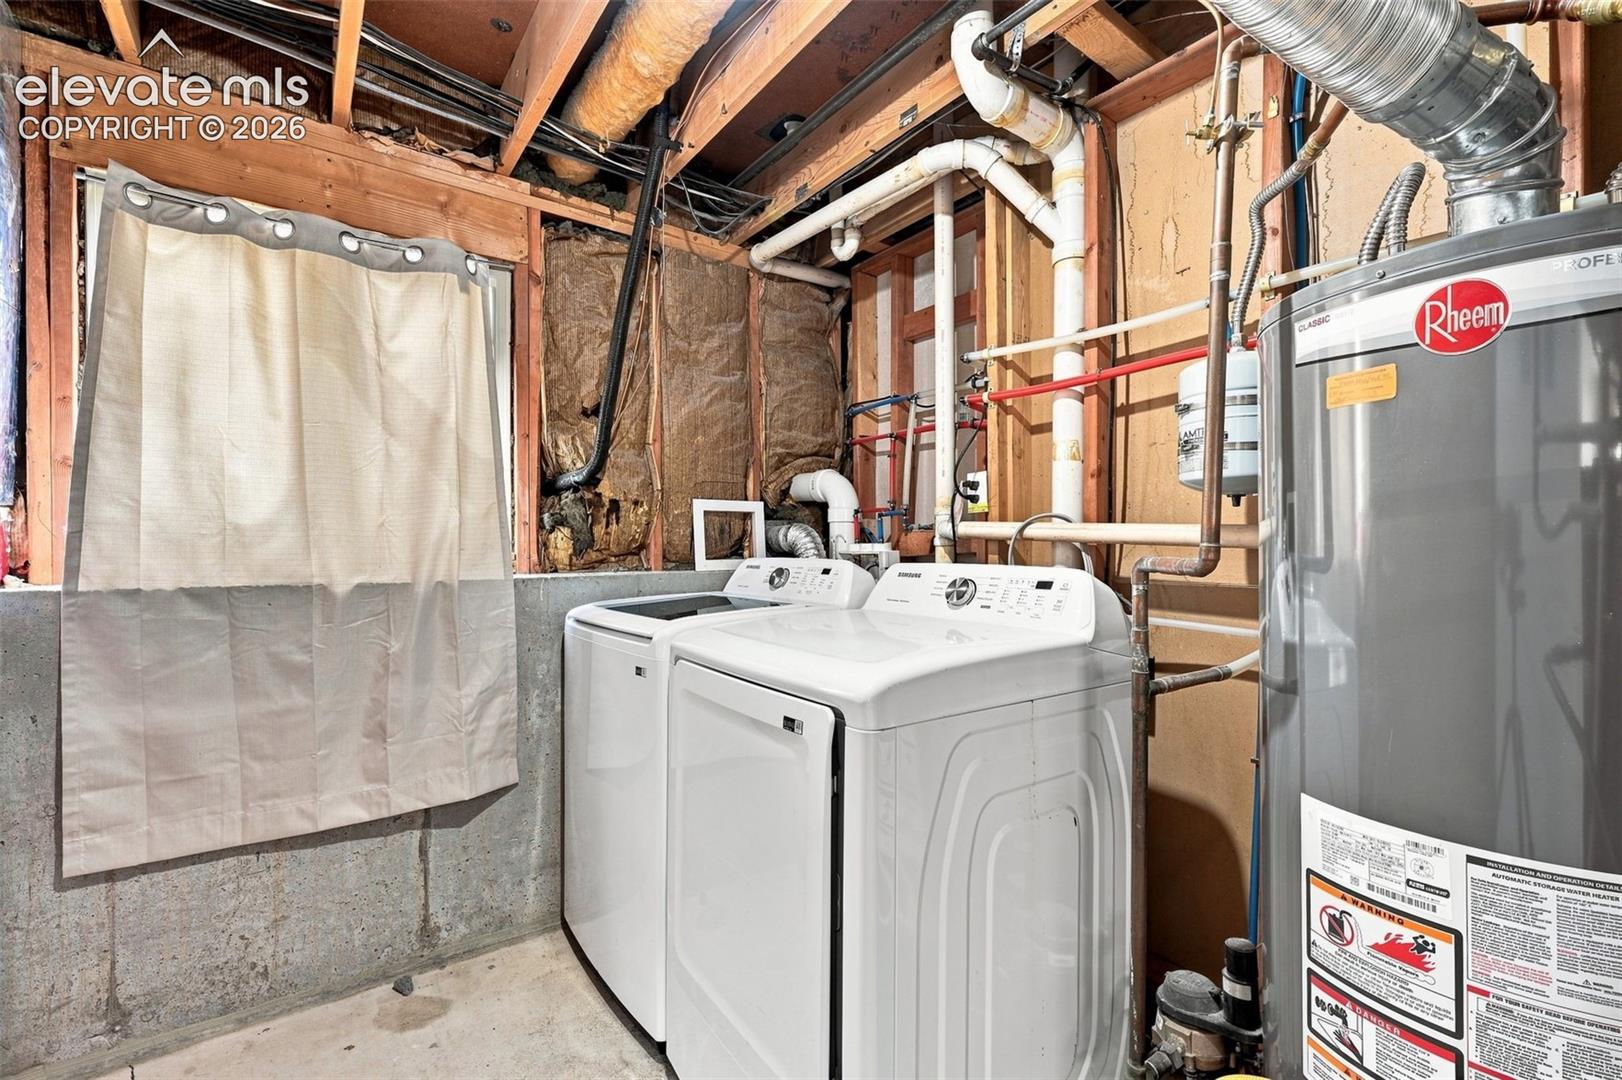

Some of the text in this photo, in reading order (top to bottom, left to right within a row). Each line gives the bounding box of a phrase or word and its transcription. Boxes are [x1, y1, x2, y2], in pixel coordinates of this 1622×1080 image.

[1297, 314, 1331, 333] CLASSIC
[1425, 285, 1505, 345] Rheem
[1486, 861, 1535, 876] INSTALLATION
[1535, 871, 1552, 881] AND
[1553, 875, 1594, 888] OPERATION
[1491, 872, 1620, 902] AUTOMATIC STORAGE WATER HEATER
[1351, 897, 1404, 925] WARNING
[1355, 1007, 1401, 1036] DANGER
[1492, 994, 1504, 1003] FOR
[1505, 998, 1521, 1008] YOUR
[1521, 1003, 1543, 1014] SAFETY
[1545, 1010, 1561, 1019] READ
[1562, 1015, 1586, 1026] BEFORE
